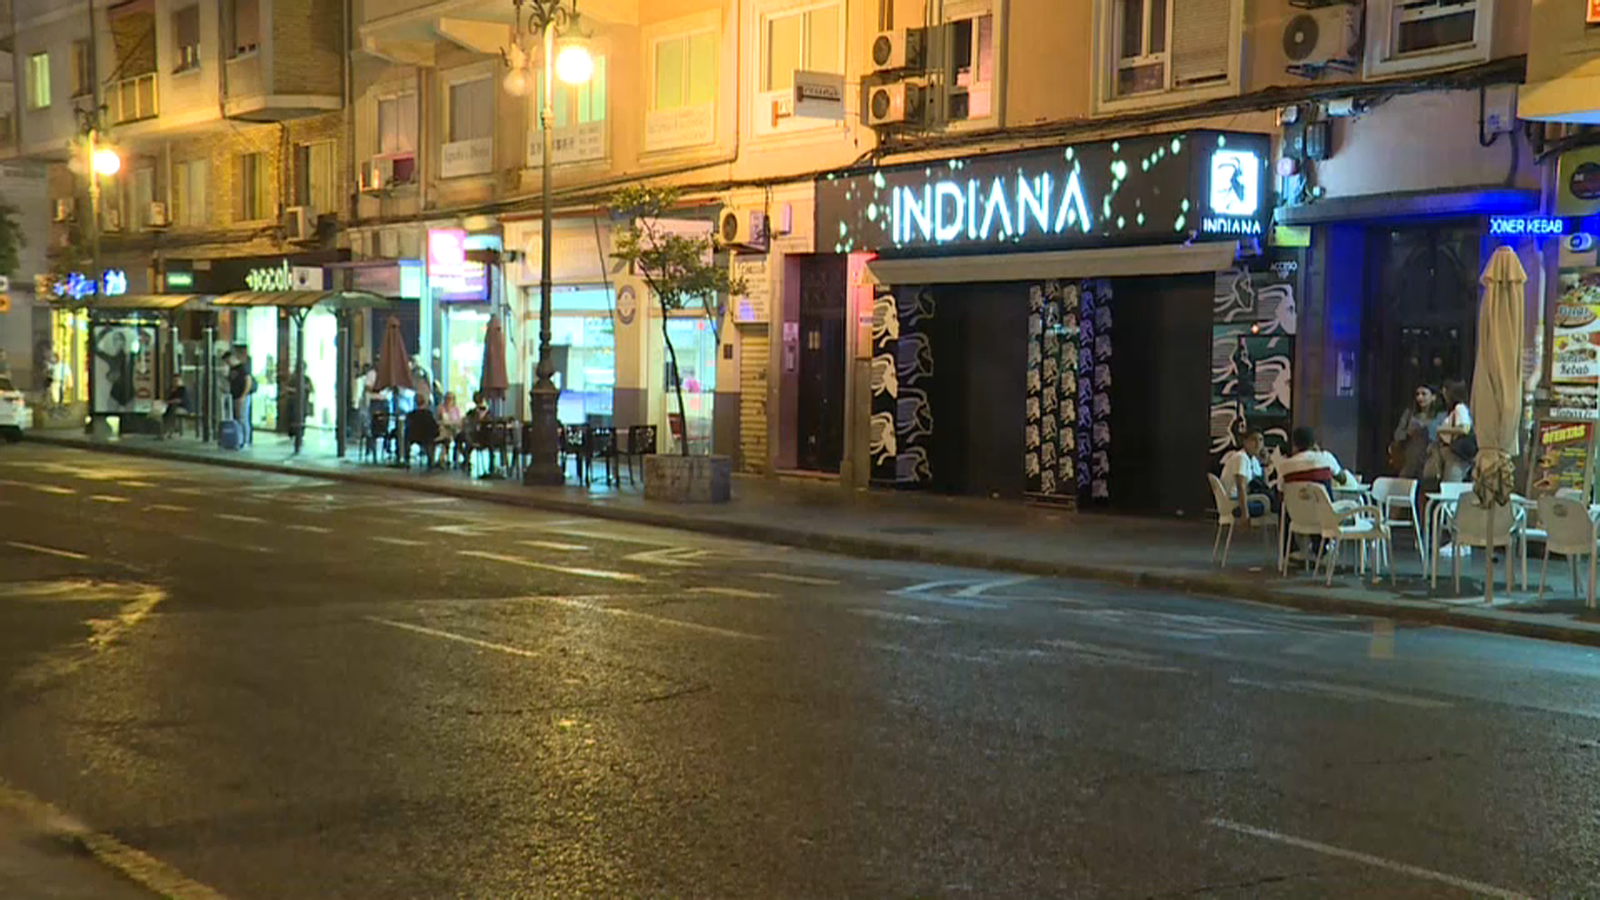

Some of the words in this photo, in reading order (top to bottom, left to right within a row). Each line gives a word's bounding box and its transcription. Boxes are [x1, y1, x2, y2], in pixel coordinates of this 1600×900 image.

[892, 169, 1093, 244] INDIANA
[1203, 218, 1261, 234] INDIANA
[1527, 218, 1563, 234] KEBAB
